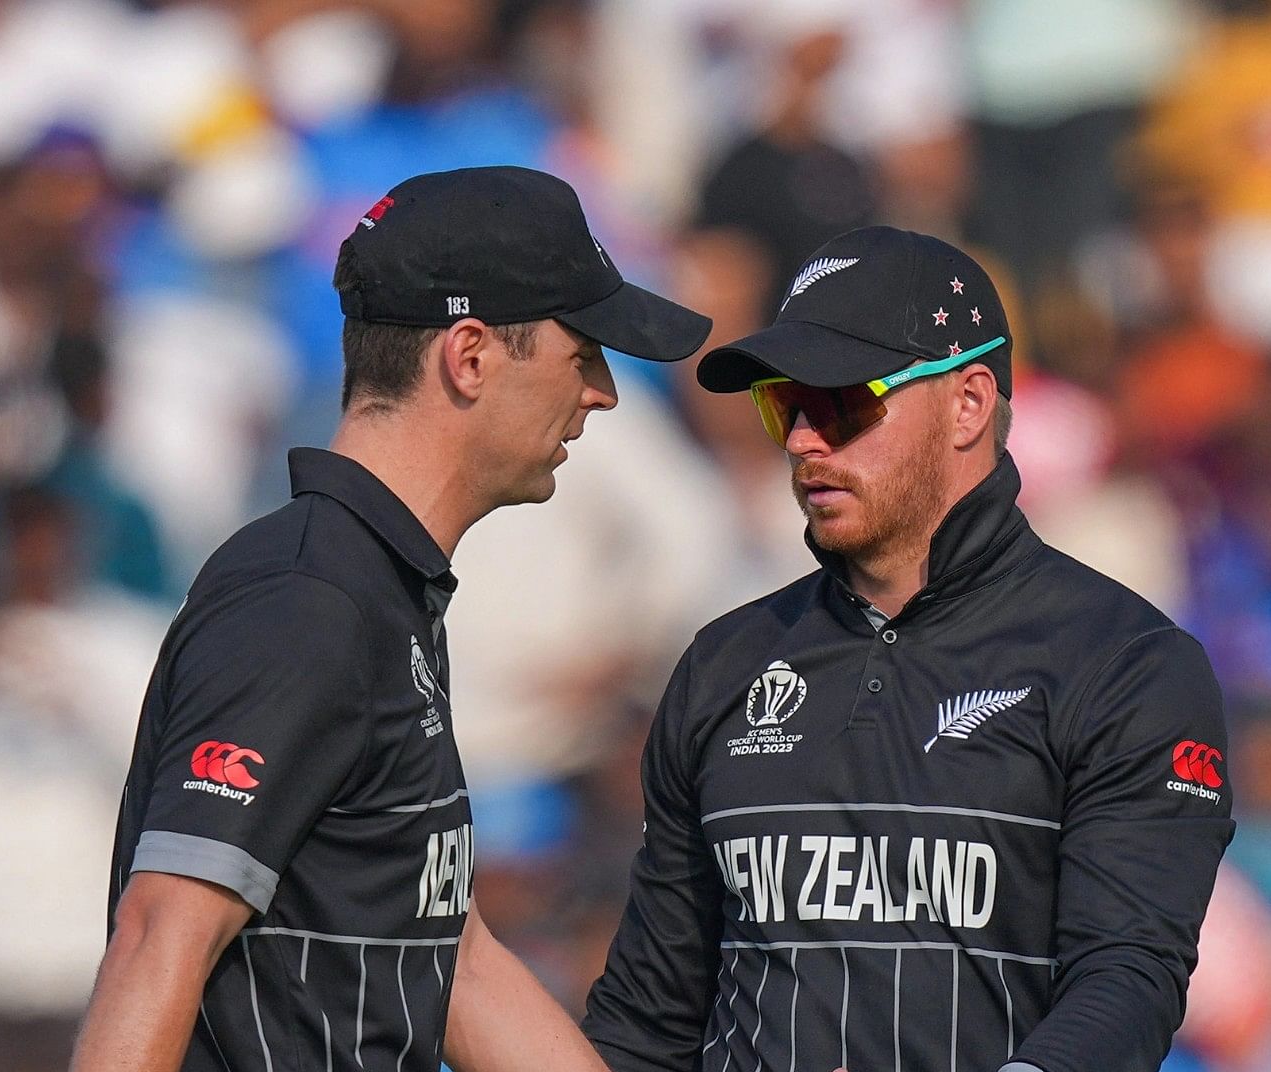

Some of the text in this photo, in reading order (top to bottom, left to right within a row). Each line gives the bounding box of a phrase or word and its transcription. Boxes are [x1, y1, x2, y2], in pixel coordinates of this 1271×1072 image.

[446, 296, 470, 315] 183
[727, 734, 803, 747] CRICKET WORLD CUP
[759, 727, 783, 736] MEN'S
[730, 743, 793, 757] INDIA 2023
[183, 780, 255, 806] canterbury
[1166, 780, 1221, 806] canterbury
[797, 834, 997, 929] ZEALAND
